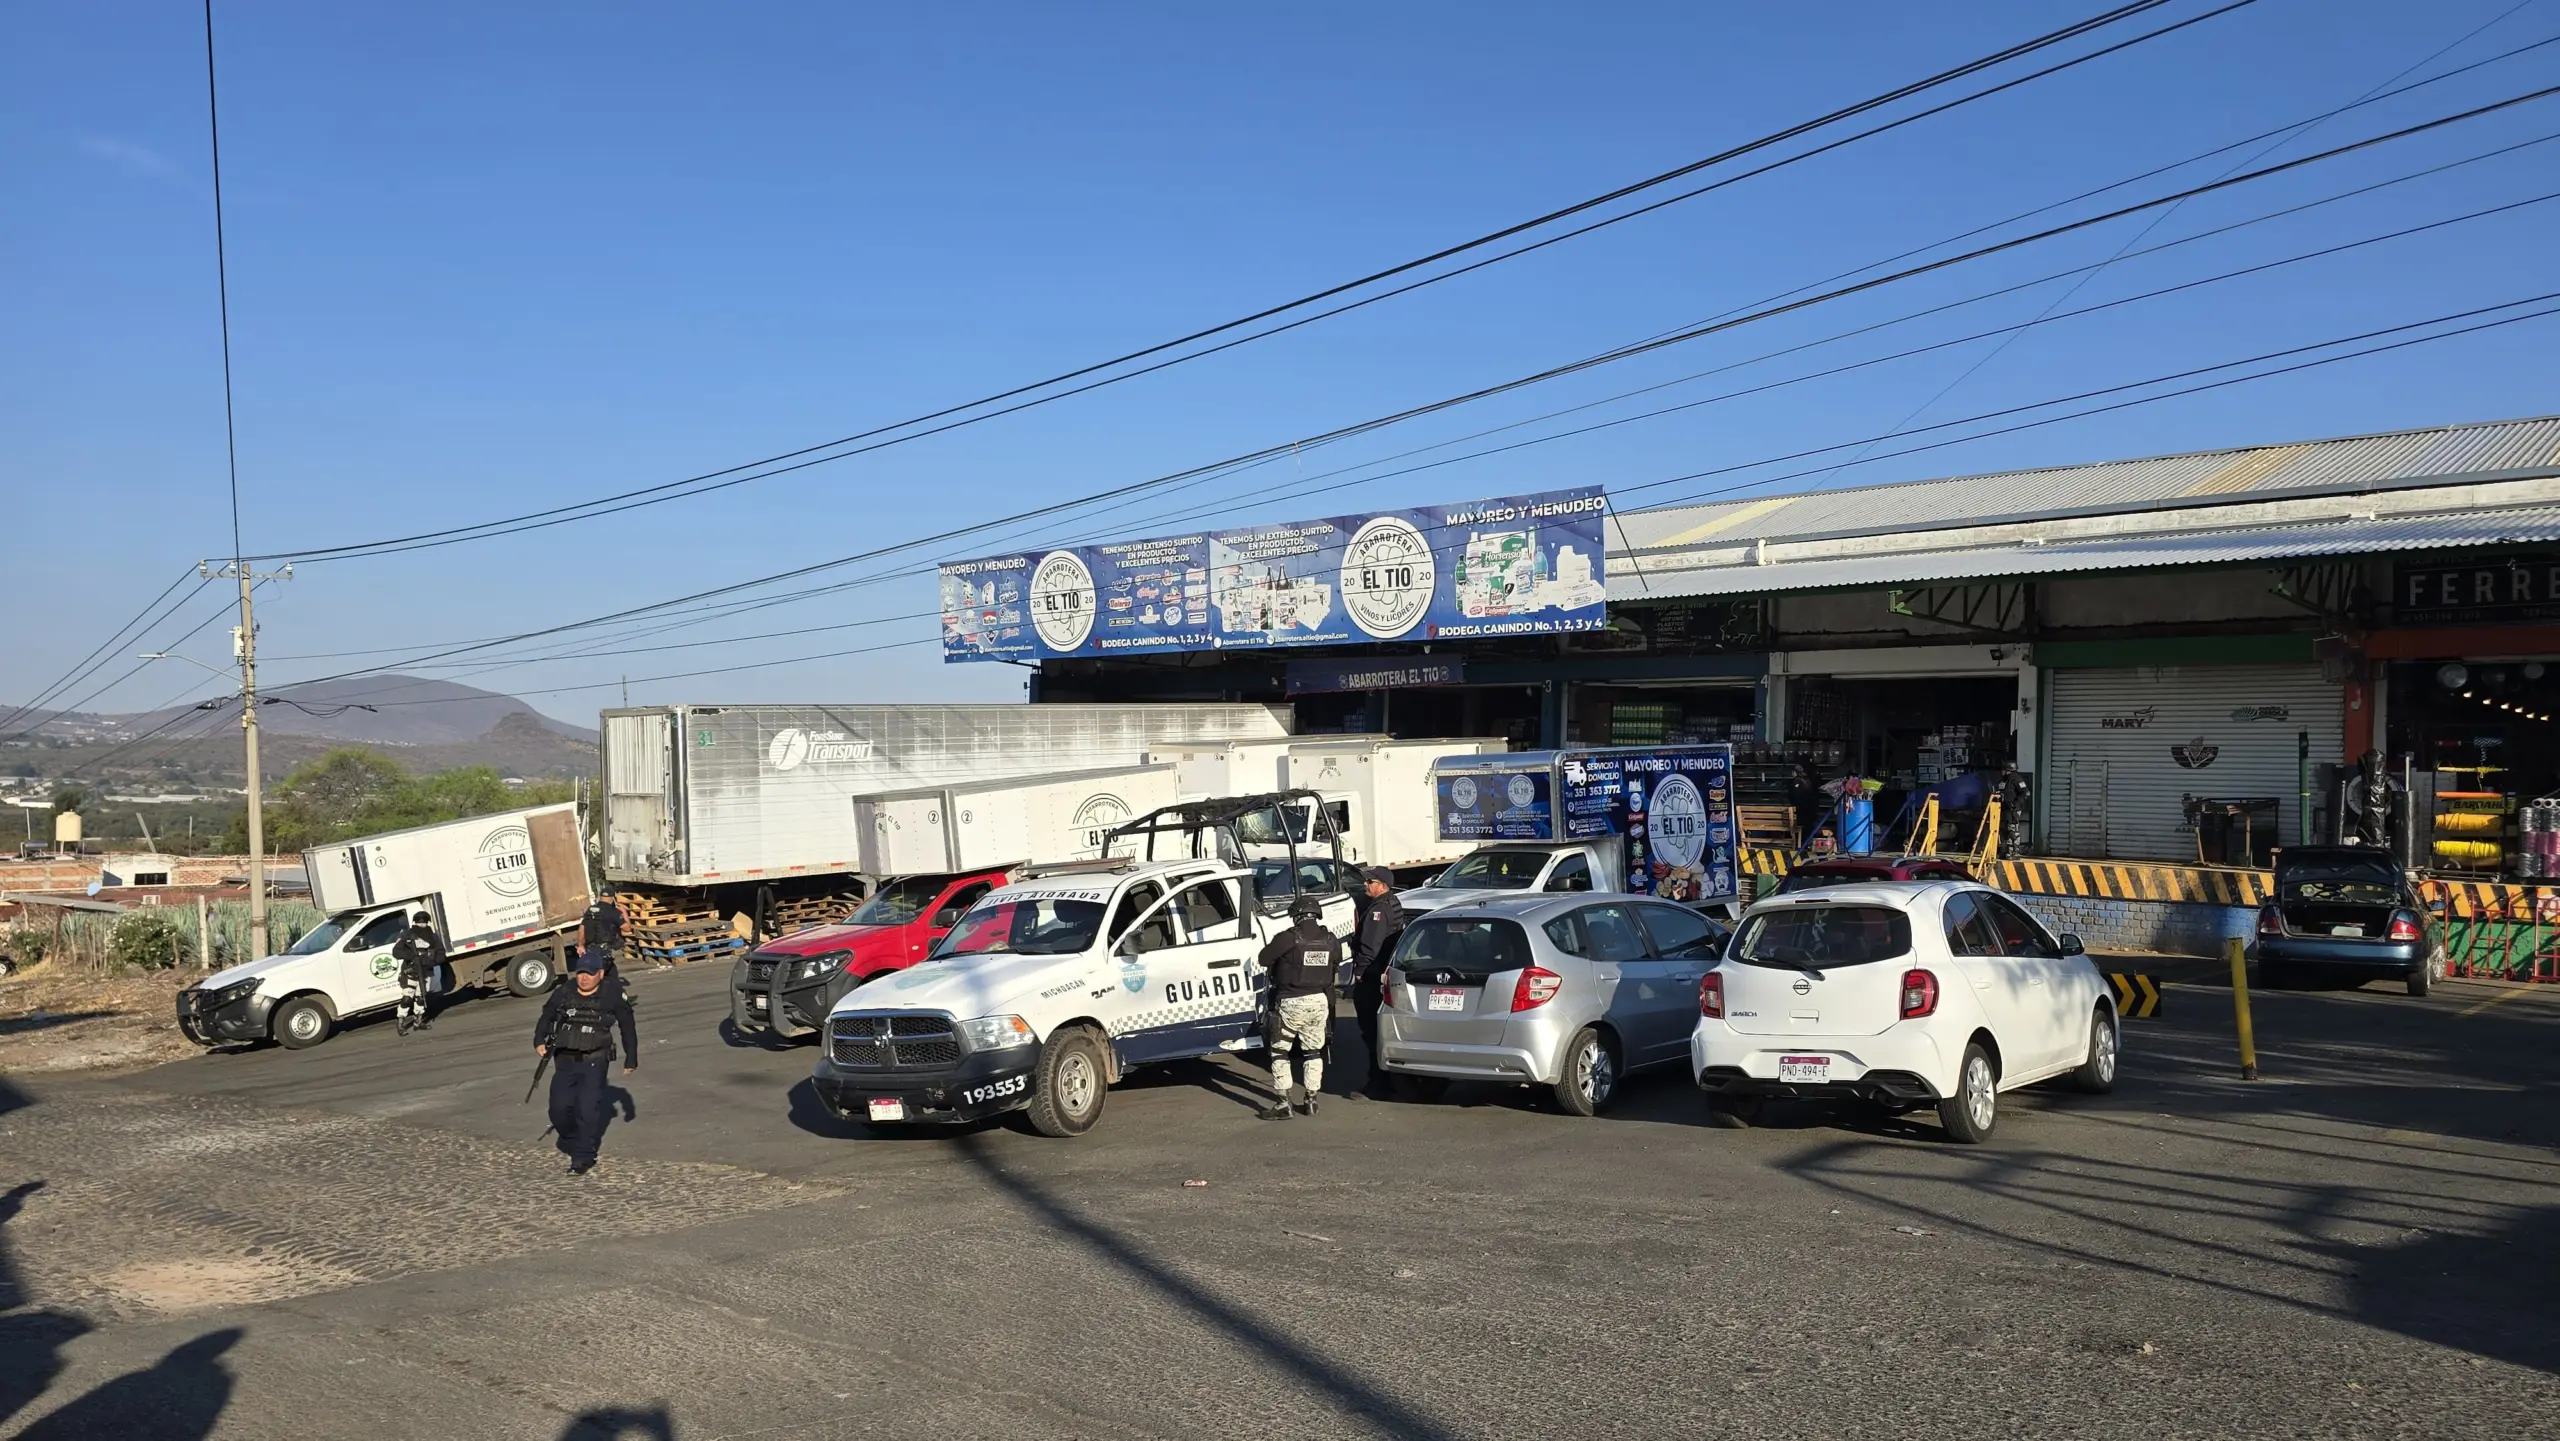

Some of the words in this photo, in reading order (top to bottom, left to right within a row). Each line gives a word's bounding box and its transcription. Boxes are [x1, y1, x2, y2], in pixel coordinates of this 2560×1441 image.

[1446, 508, 1515, 526] MAYOREO
[1517, 506, 1528, 518] Y
[1531, 497, 1605, 517] MENUDEO
[1220, 534, 1253, 545] TENEMOS
[1255, 533, 1265, 541] UN
[1266, 530, 1300, 540] EXTENSO
[1301, 525, 1334, 536] SURTIDO
[1260, 537, 1304, 549] PRODUCTOS
[1102, 544, 1132, 554] TENEMOS
[1132, 543, 1142, 551] UN
[1143, 541, 1173, 550] EXTENSO
[1174, 536, 1203, 546] SURTIDO
[1242, 548, 1286, 560] EXCELENTES
[1287, 544, 1319, 555] PRECIOS
[1360, 532, 1413, 557] ABARROTERA
[1122, 558, 1160, 568] EXCELENTES
[1161, 554, 1190, 563] PRECIOS
[1137, 548, 1176, 558] PRODUCTOS
[1485, 551, 1521, 562] Hortensia
[939, 564, 977, 577] MAYOREO
[978, 562, 984, 571] Y
[985, 558, 1026, 571] MENUDEO
[1043, 564, 1079, 583] ABARROTERA
[1344, 578, 1355, 586] 20
[1363, 570, 1380, 589] EL
[1385, 567, 1411, 587] TIO
[1419, 572, 1431, 580] 20
[1046, 594, 1058, 610] EL
[1061, 592, 1079, 609] TIO
[1360, 604, 1379, 621] VINOS
[1386, 601, 1414, 622] LICORES
[1439, 626, 1481, 636] BODEGA
[1483, 623, 1533, 634] CANINDO
[1535, 621, 1552, 631] No.
[1554, 621, 1562, 632] 1,
[1564, 620, 1574, 631] 2,
[1576, 619, 1583, 628] 3
[1584, 620, 1592, 631] y
[1594, 618, 1603, 627] 4
[1102, 639, 1131, 648] BODEGA
[1132, 636, 1165, 646] CANINDO
[1206, 633, 1212, 641] 4
[1348, 670, 1406, 688] ABARROTERA
[1409, 669, 1420, 683] EL
[1423, 667, 1439, 682] TIO
[1760, 674, 1768, 689] 4
[2101, 719, 2145, 728] MARY
[698, 730, 713, 747] 31
[808, 742, 874, 761] Transport
[1587, 762, 1614, 771] SERVICIO
[1625, 759, 1671, 772] MAYOREO
[1673, 759, 1680, 770] Y
[1681, 758, 1725, 770] MENUDEO
[1588, 772, 1619, 782] DOMICILIO
[1574, 788, 1586, 798] 351
[1589, 786, 1602, 796] 363
[1603, 784, 1621, 795] 3772
[1661, 786, 1693, 806] ABARROTERA
[1475, 826, 1493, 834] 3772
[1650, 824, 1658, 832] 20
[1663, 817, 1675, 835] EL
[1677, 816, 1694, 834] TIO
[1697, 821, 1705, 829] 20
[1089, 830, 1100, 846] EL
[496, 857, 507, 870] EL
[508, 853, 527, 867] TIO
[485, 904, 515, 916] SERVICIO
[1165, 971, 1251, 1004] GUARDI
[1781, 1065, 1828, 1077] PND-494-E
[963, 1075, 1026, 1105] 193553
